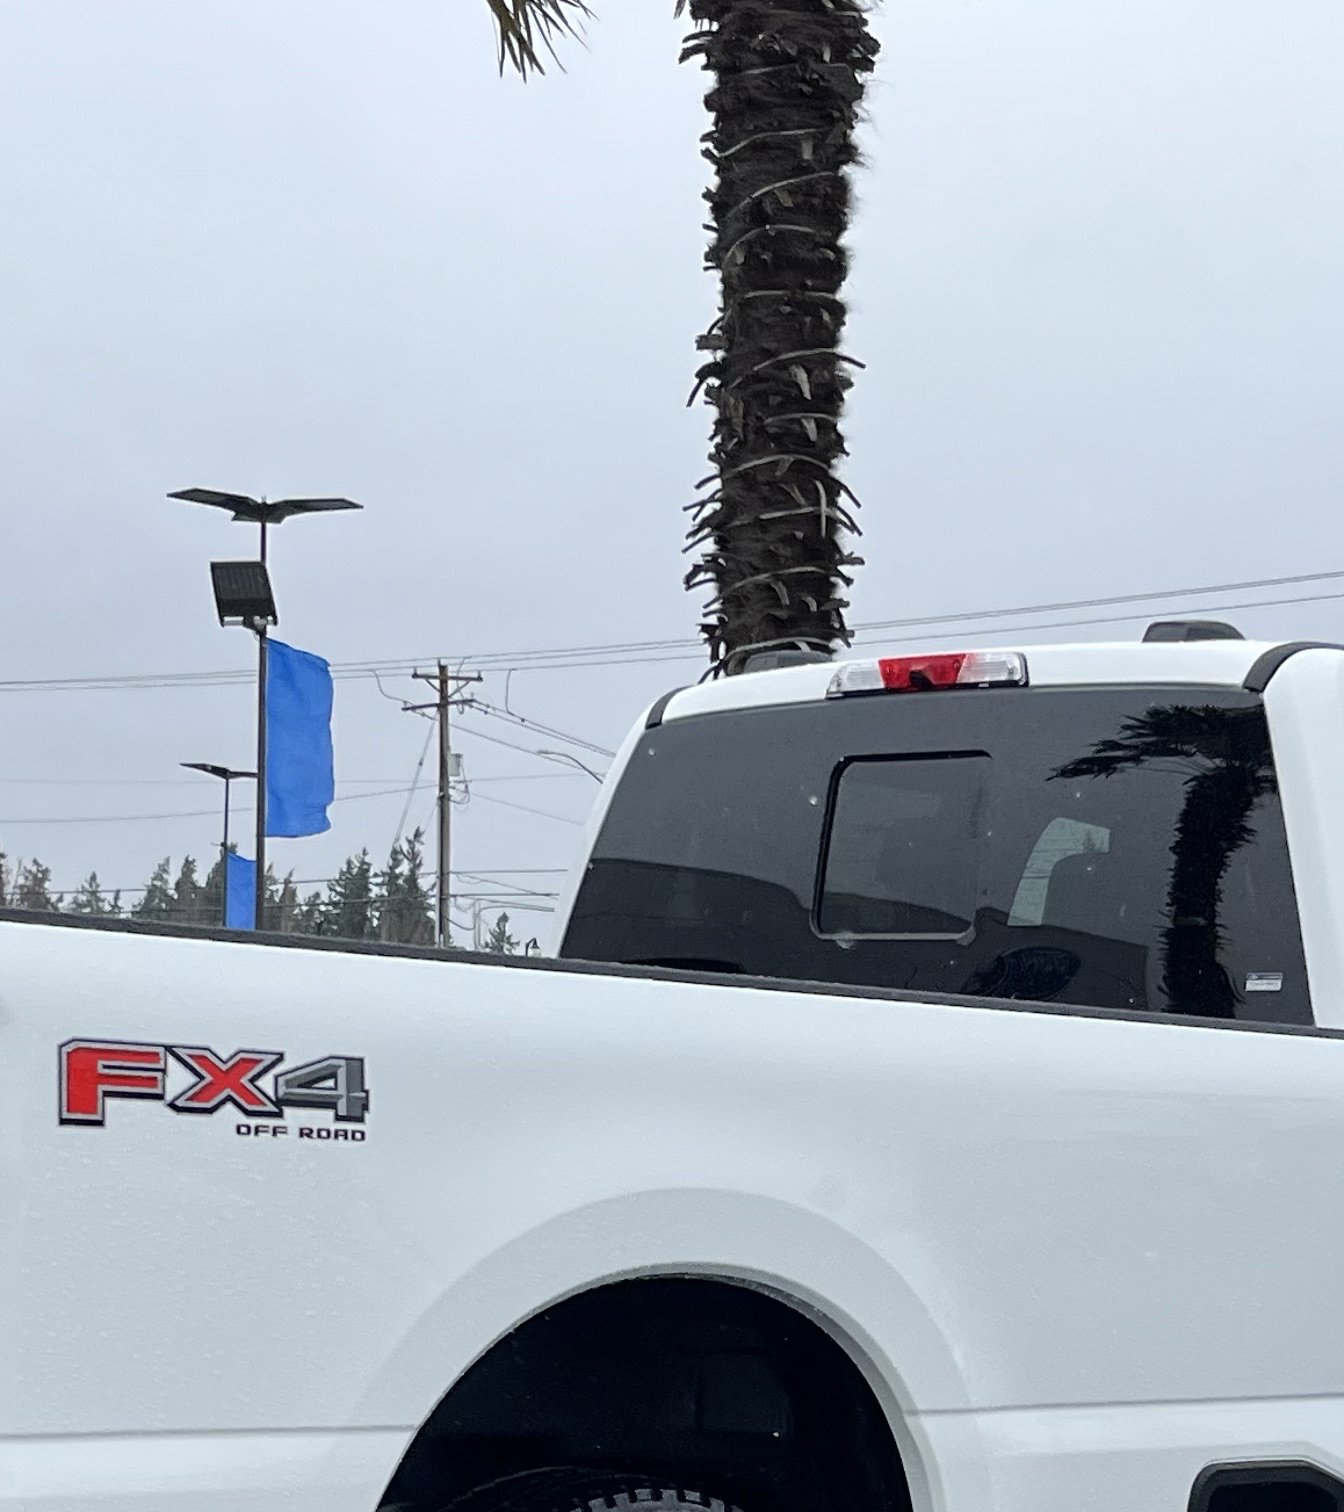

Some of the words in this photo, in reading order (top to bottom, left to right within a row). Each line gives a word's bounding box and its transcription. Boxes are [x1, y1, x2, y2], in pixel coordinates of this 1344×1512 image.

[58, 1037, 369, 1126] FX4
[236, 1123, 288, 1137] OFF
[298, 1126, 367, 1142] ROAD
